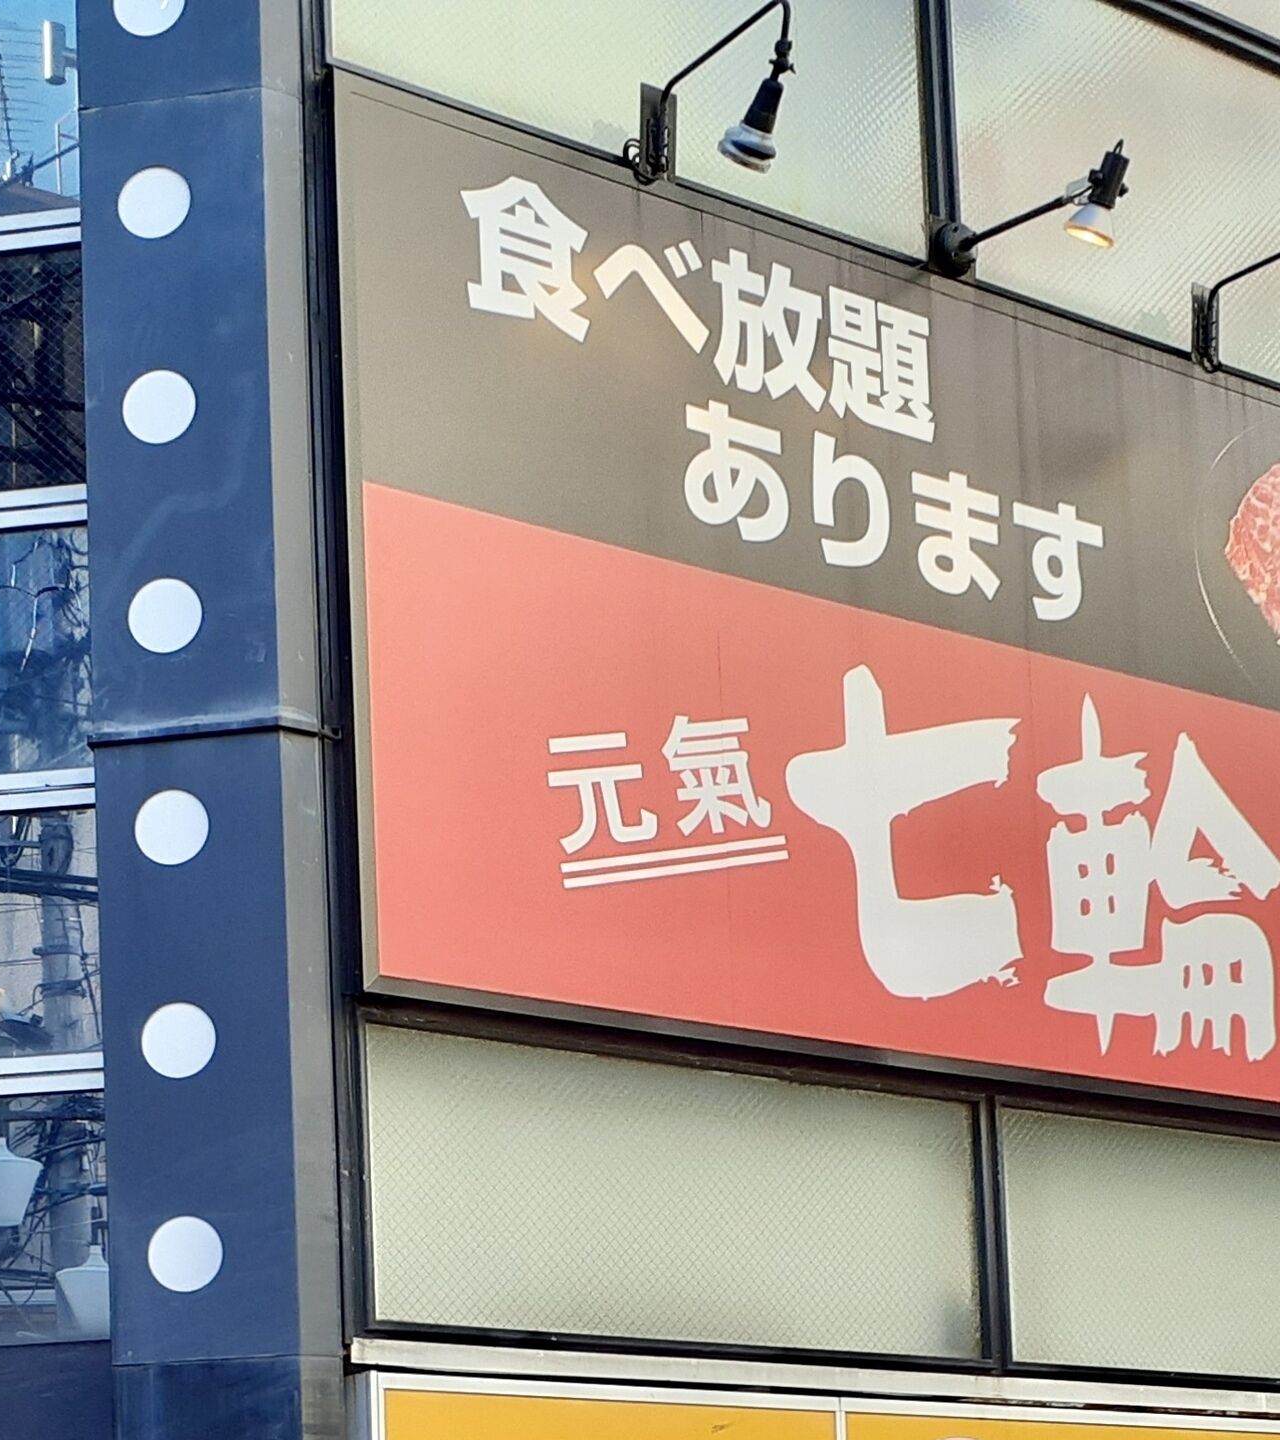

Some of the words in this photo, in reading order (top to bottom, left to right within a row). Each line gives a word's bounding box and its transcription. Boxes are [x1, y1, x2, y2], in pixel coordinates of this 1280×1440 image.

[460, 174, 935, 443] 食べ放題
[683, 399, 1105, 621] あります
[547, 714, 773, 855] 元氣
